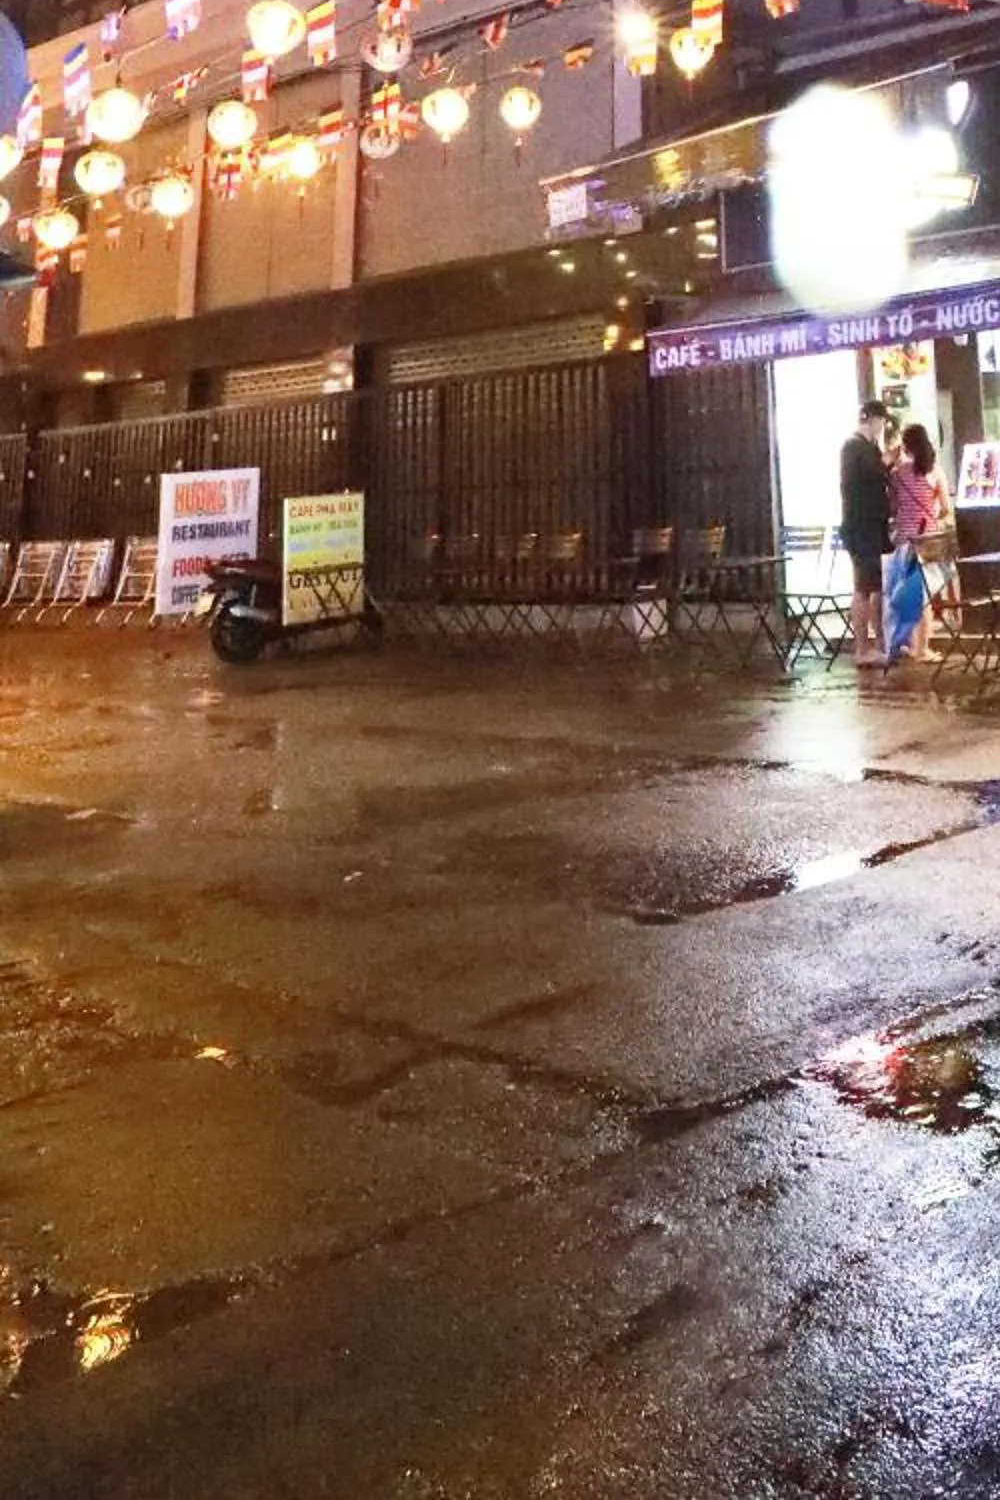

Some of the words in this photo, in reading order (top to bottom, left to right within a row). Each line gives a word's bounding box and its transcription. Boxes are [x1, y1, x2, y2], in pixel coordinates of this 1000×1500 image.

[720, 332, 774, 362] BÁNH
[827, 314, 879, 345] SINH
[887, 304, 914, 336] TỐ
[935, 294, 1000, 331] NƯỚC
[172, 520, 251, 542] RESTAURANT
